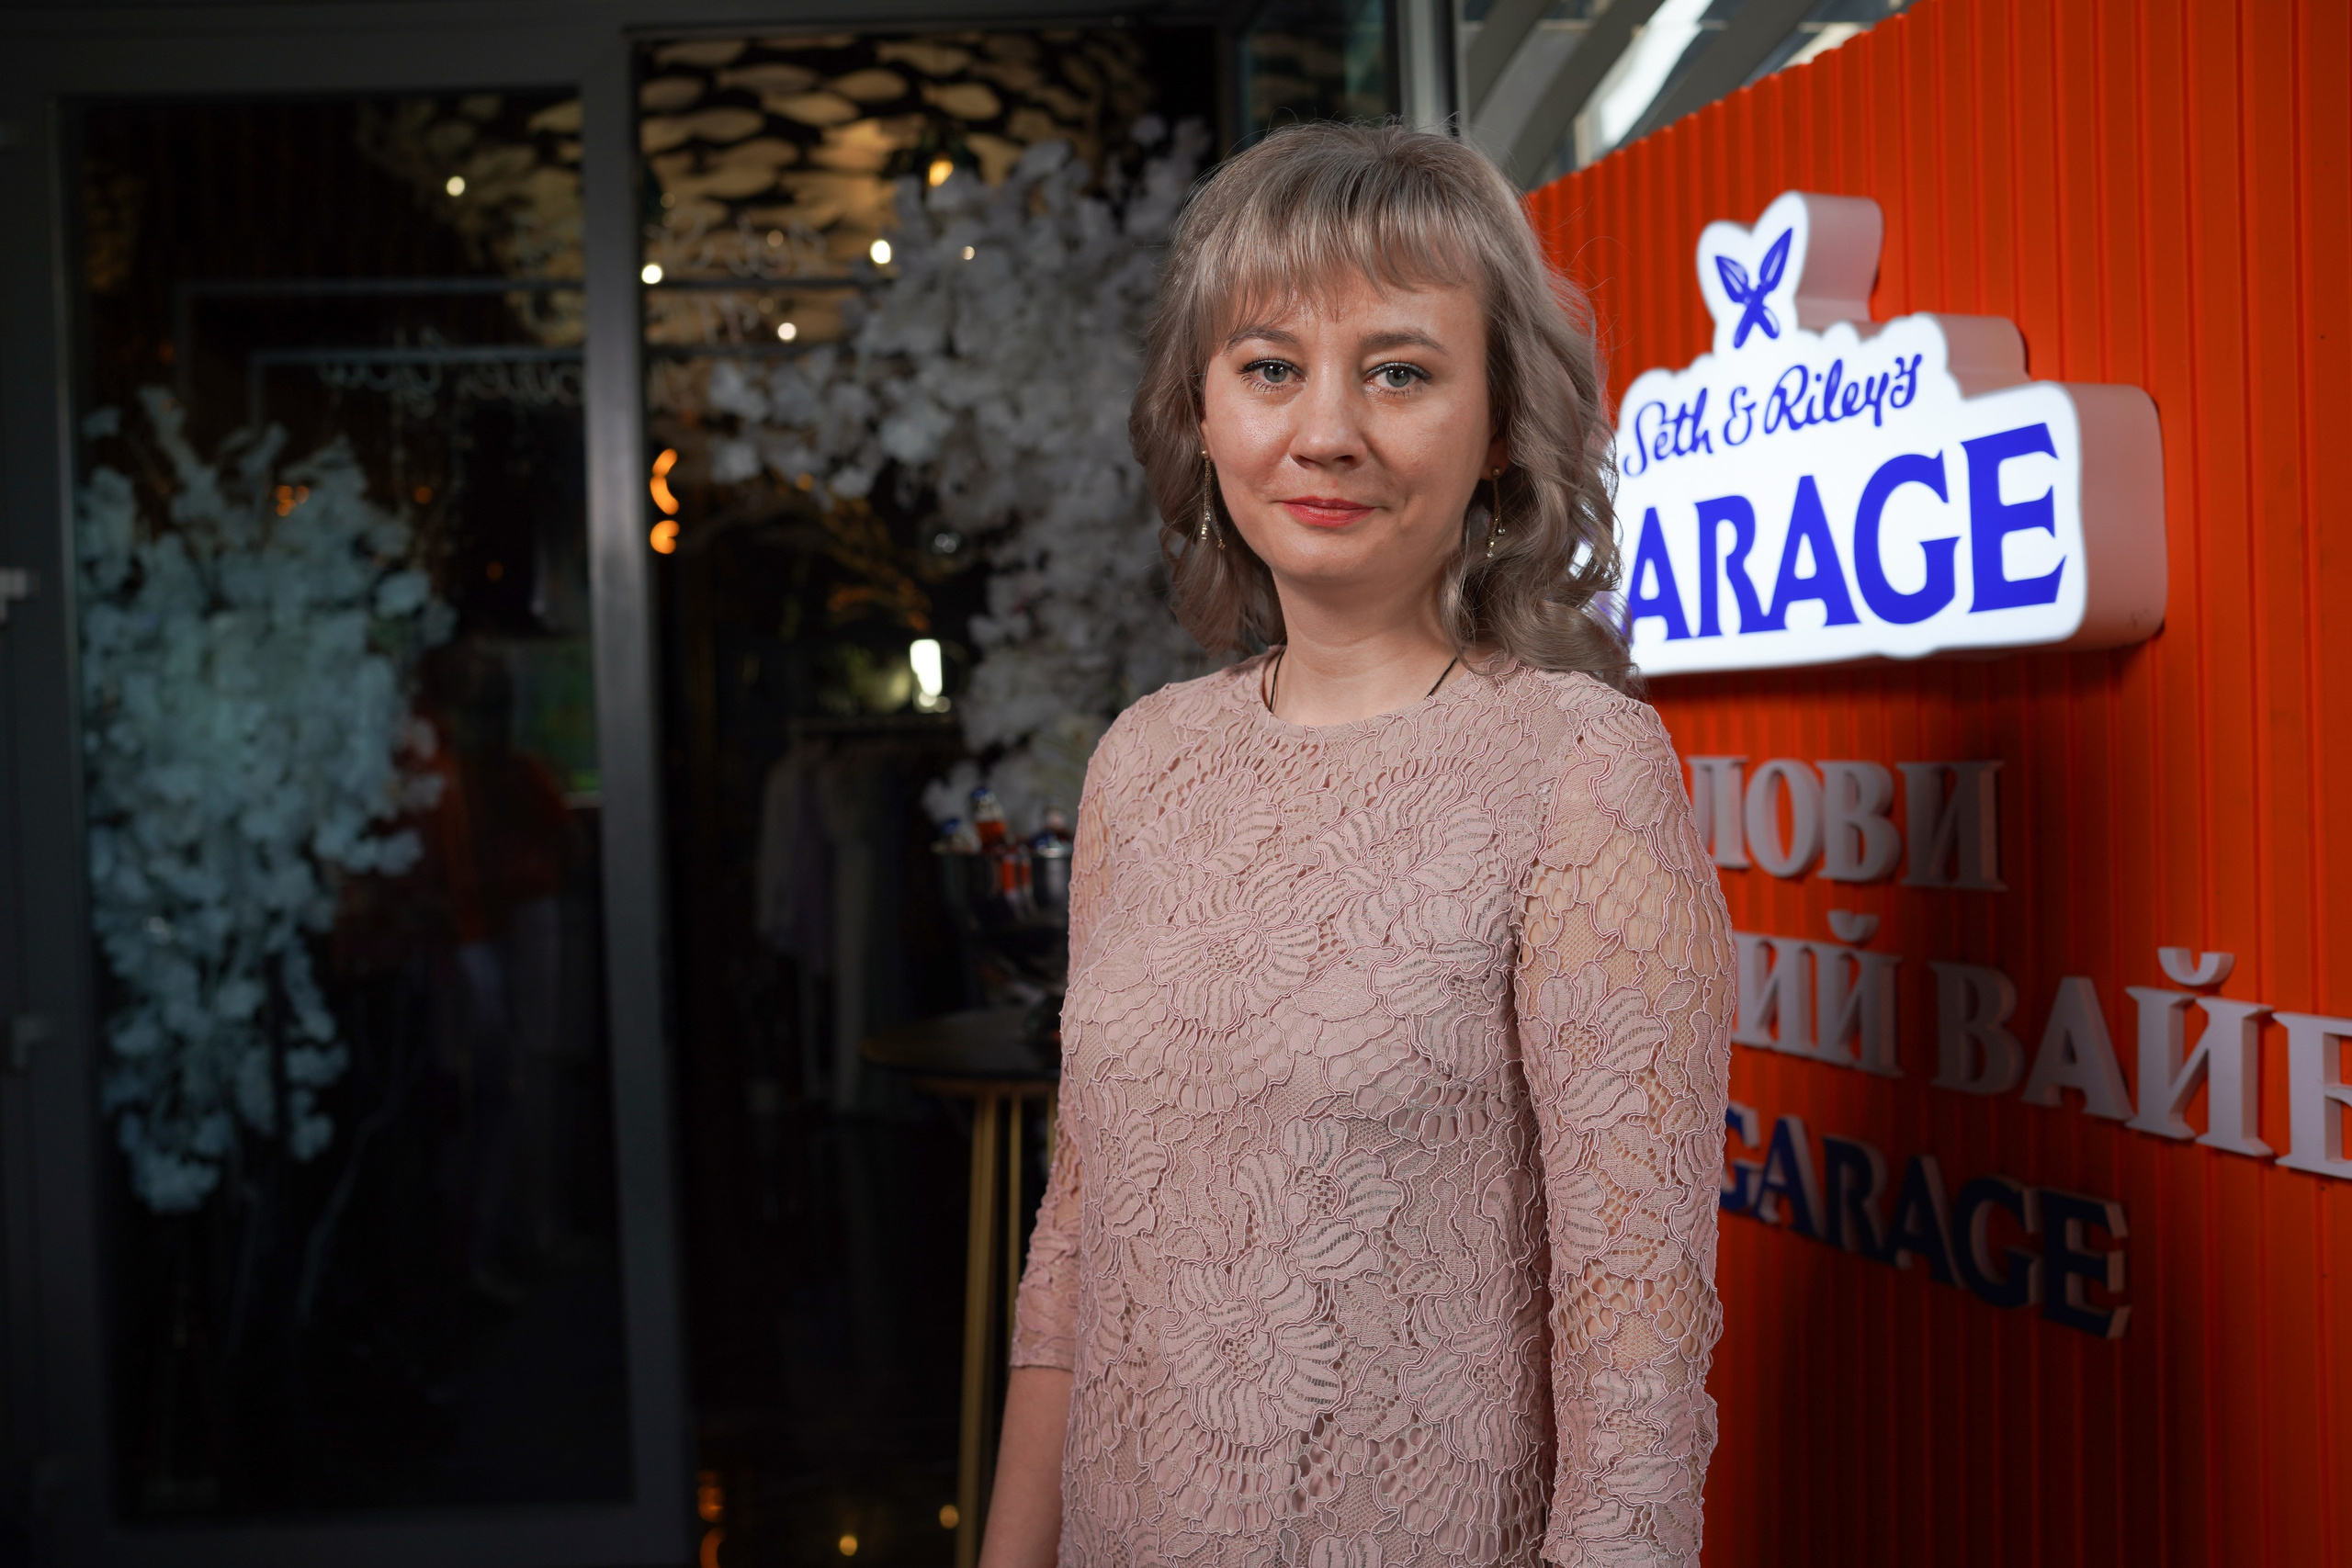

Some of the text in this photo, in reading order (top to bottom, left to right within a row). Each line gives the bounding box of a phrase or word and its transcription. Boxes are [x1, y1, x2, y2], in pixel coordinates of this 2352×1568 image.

[1623, 353, 1923, 477] Seth & Riley's
[1623, 421, 2067, 641] ARAGE
[1731, 908, 1906, 1081] ИЙ
[1720, 1100, 2133, 1341] GARAGE
